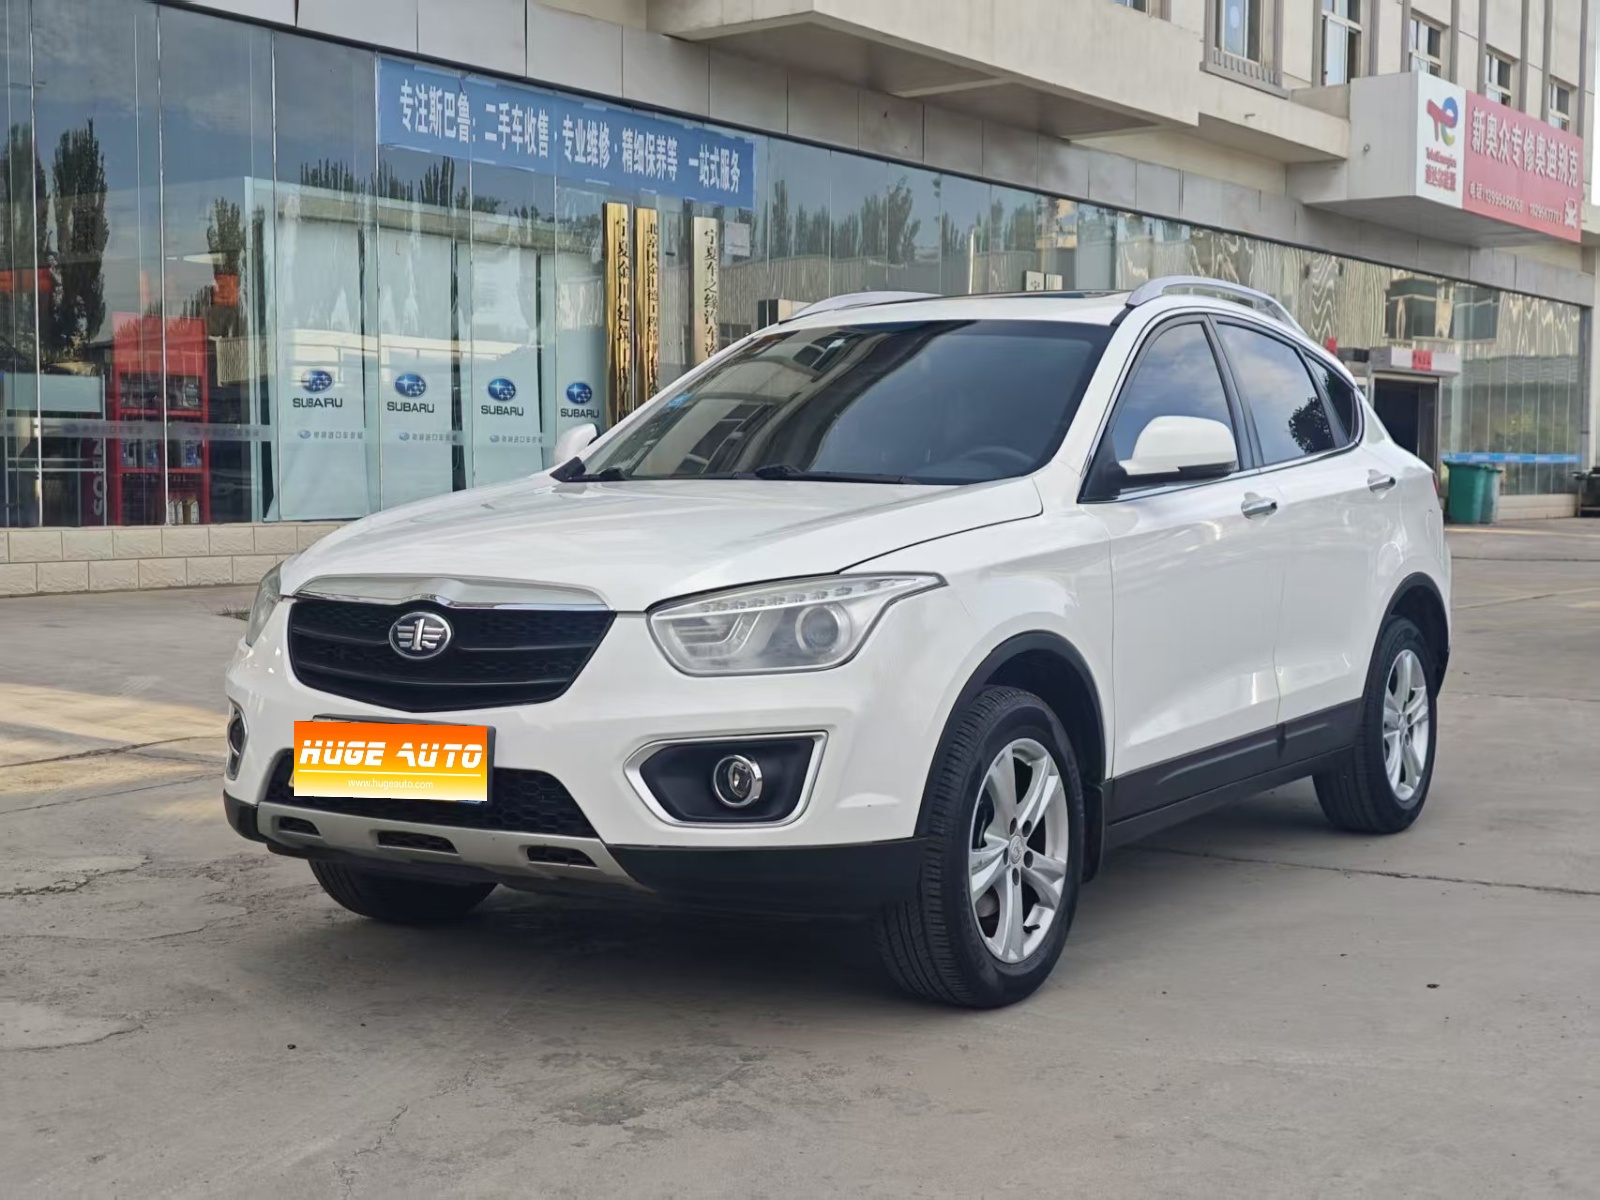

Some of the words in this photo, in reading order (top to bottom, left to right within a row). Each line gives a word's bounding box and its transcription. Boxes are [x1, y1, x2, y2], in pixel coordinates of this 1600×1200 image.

[292, 397, 343, 408] SUBARU
[387, 401, 435, 414] SUBARU
[481, 405, 524, 417] SUBARU
[560, 408, 599, 419] SUBARU
